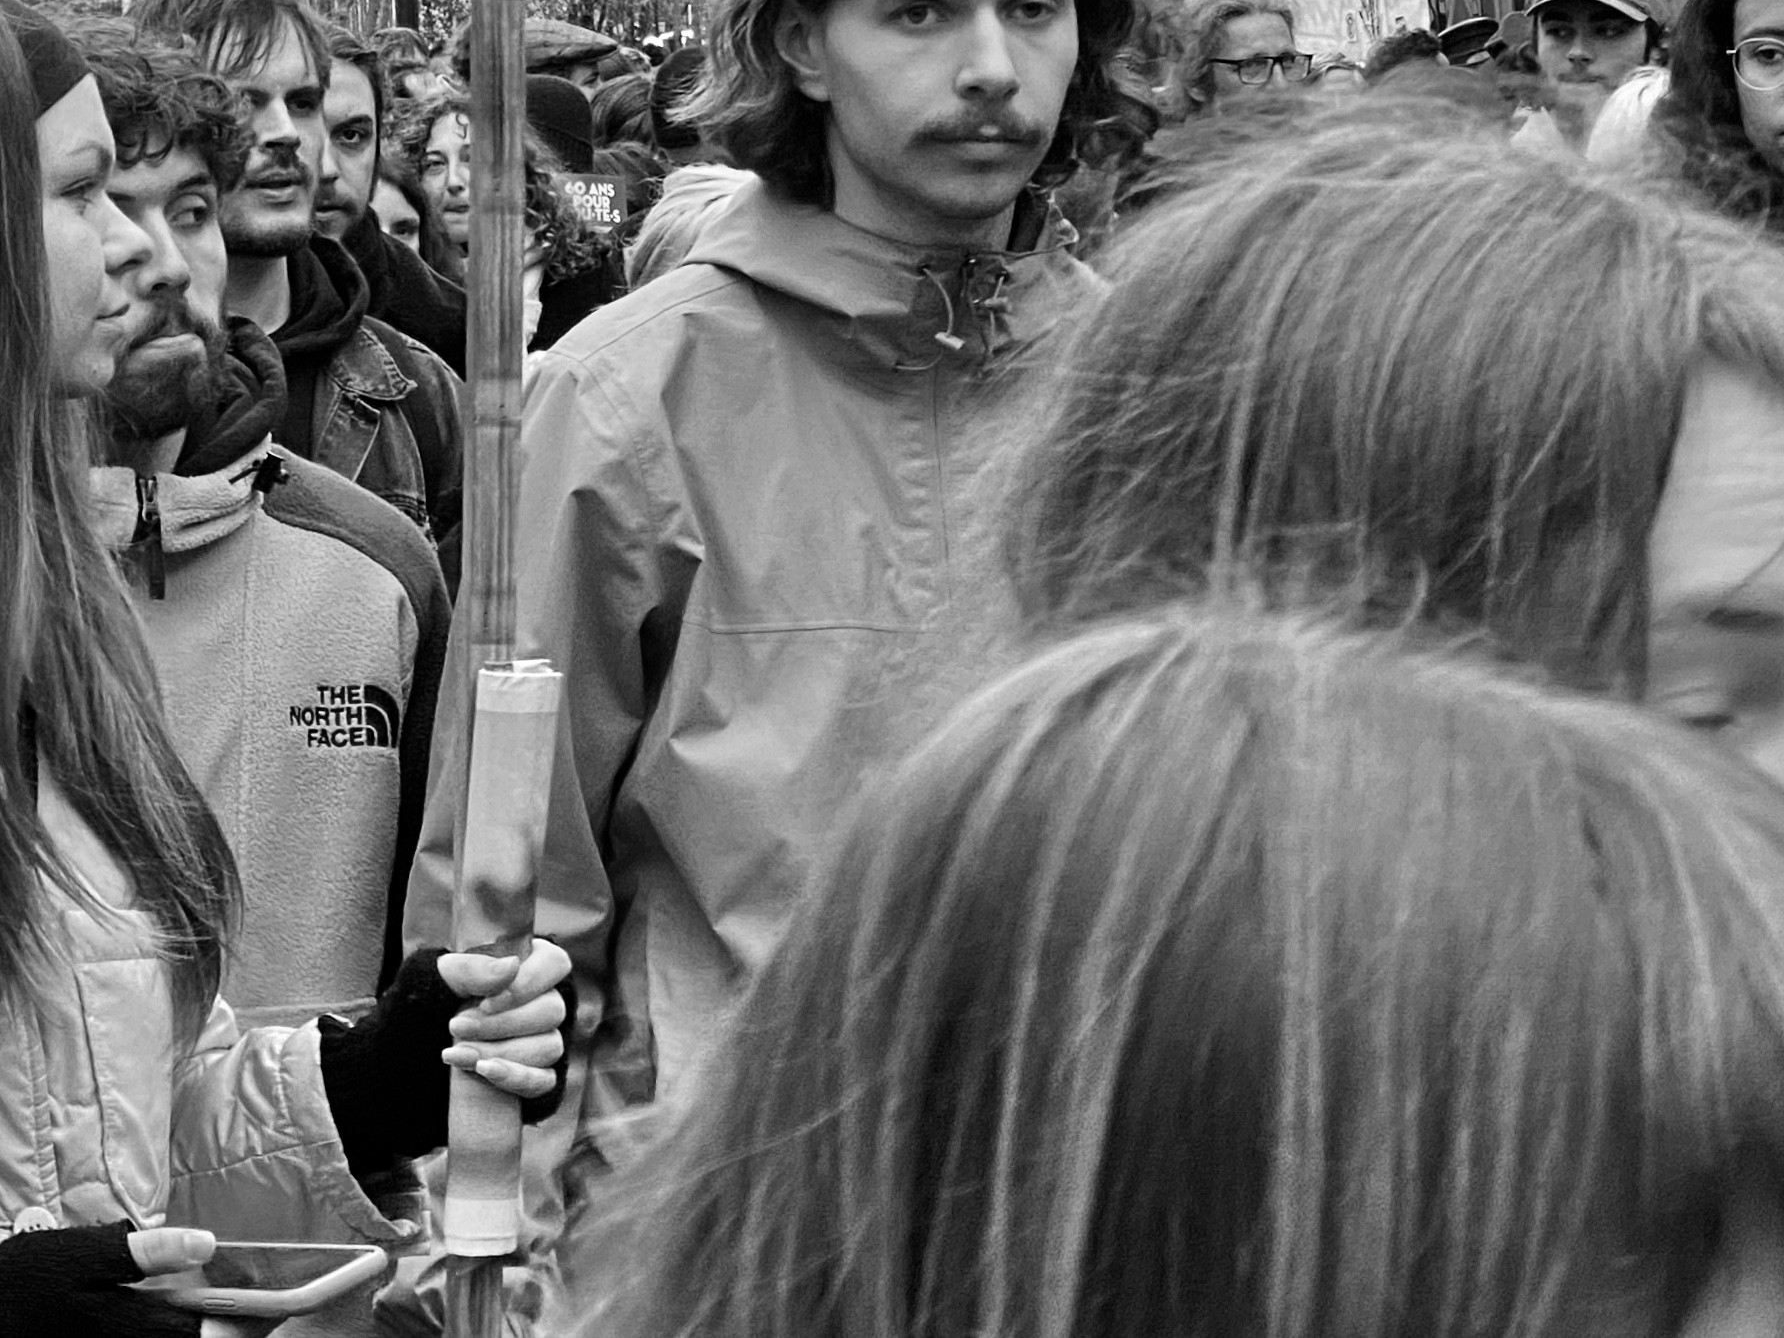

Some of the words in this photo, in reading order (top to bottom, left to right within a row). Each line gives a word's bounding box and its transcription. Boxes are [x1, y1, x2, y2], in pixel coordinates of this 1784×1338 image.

[564, 180, 587, 195] 60
[589, 182, 616, 198] ANS
[573, 193, 611, 210] POUR
[317, 685, 363, 705] THE
[289, 705, 363, 727] NORTH
[307, 726, 365, 748] FACE
